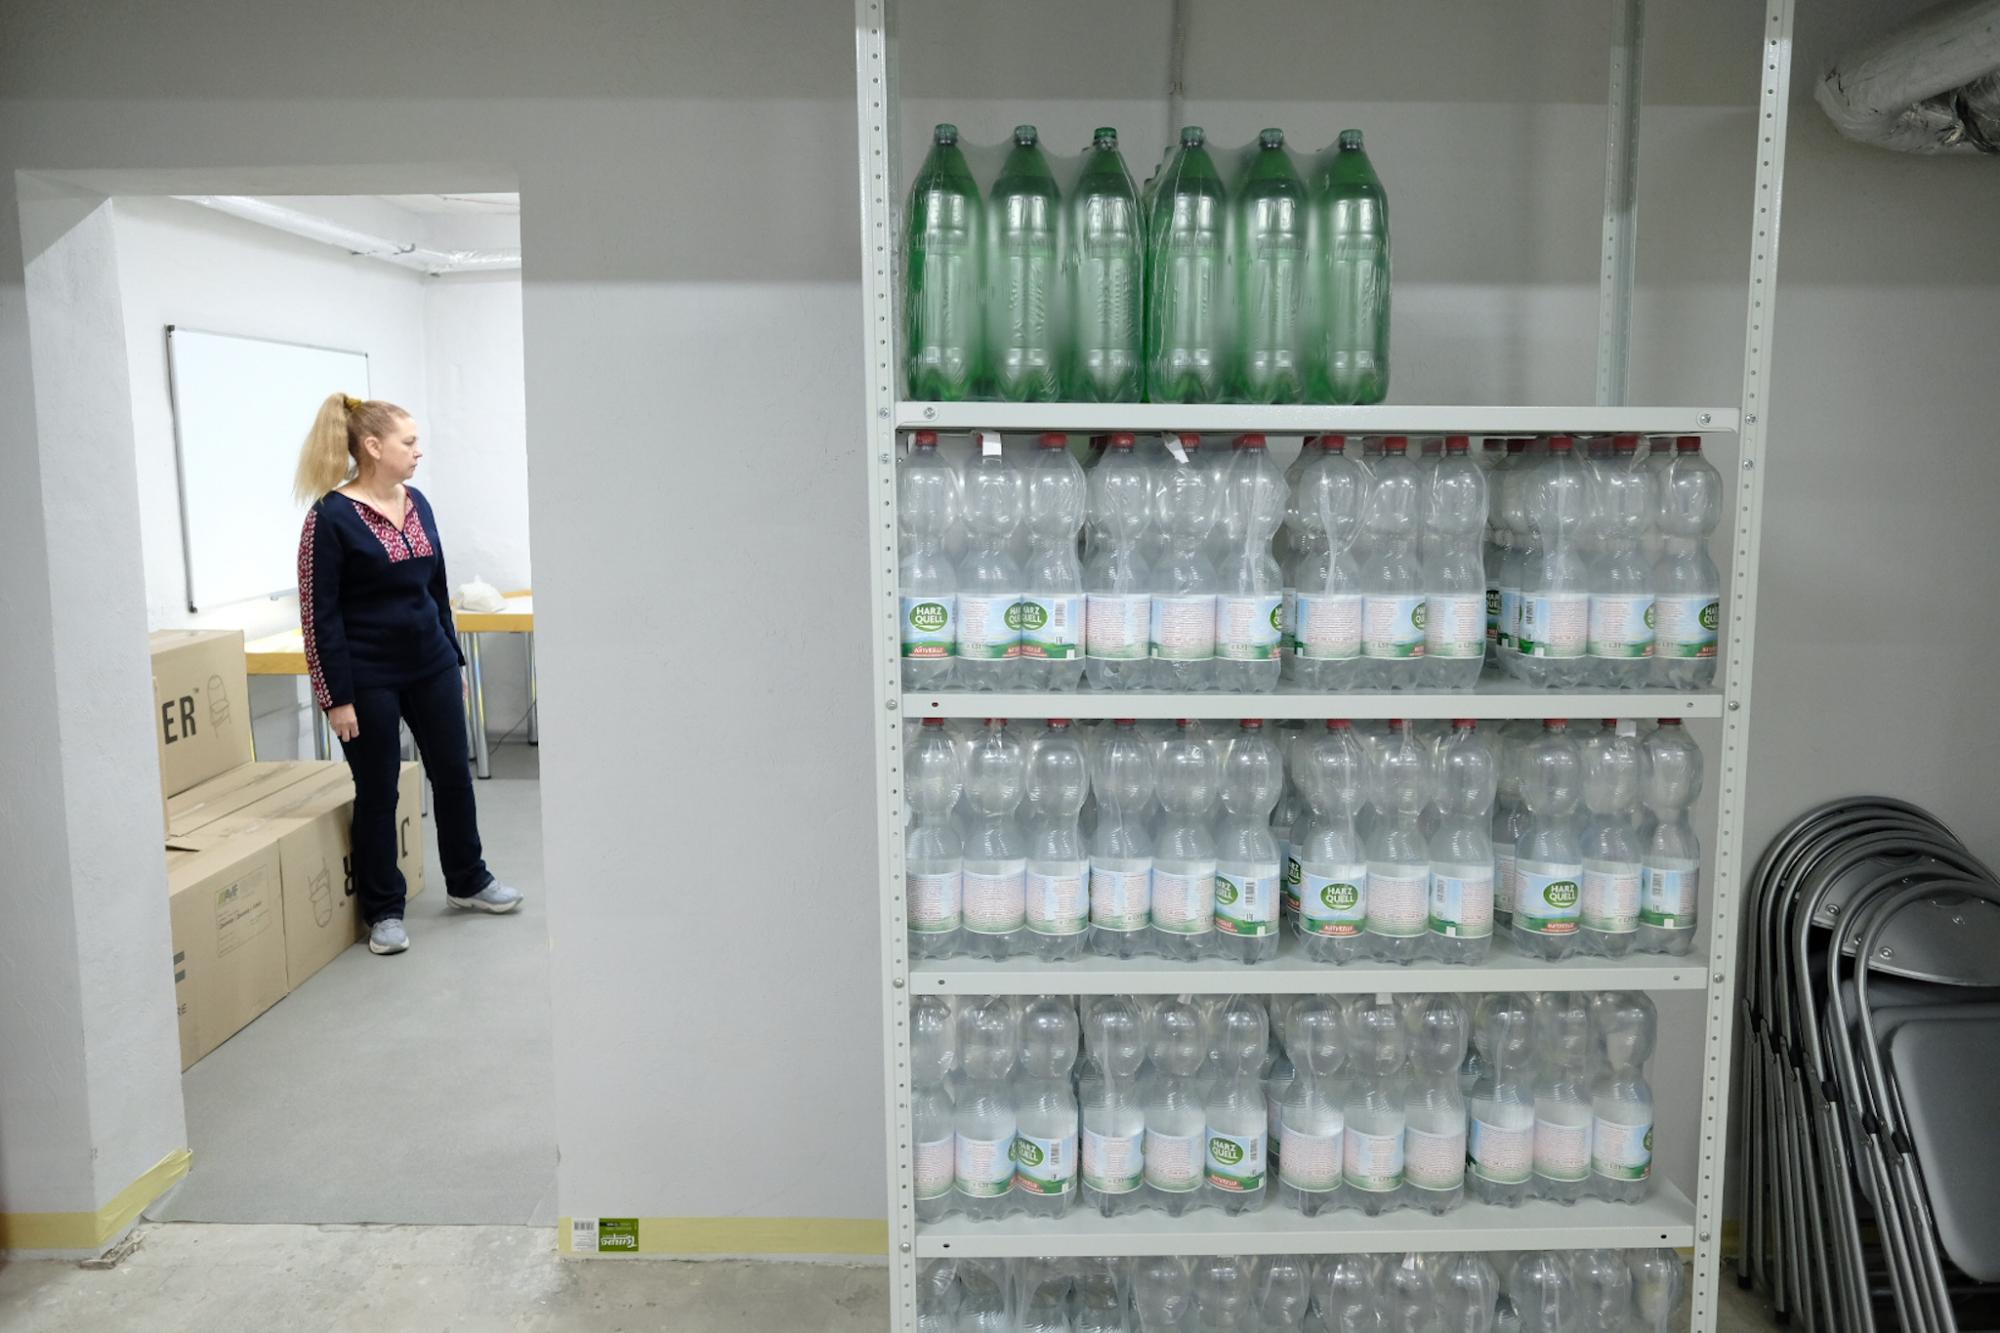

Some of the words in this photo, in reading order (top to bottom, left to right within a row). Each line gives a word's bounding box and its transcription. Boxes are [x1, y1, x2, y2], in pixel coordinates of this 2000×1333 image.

[916, 606, 943, 616] HARZ
[914, 615, 945, 625] QUELL
[162, 695, 196, 745] ER
[1327, 886, 1353, 895] HARZ
[1551, 883, 1575, 893] HARZ
[1325, 894, 1354, 904] QUELL
[1549, 892, 1575, 902] QUELL
[1213, 1139, 1236, 1152] HARZ
[1212, 1147, 1238, 1160] QUELL
